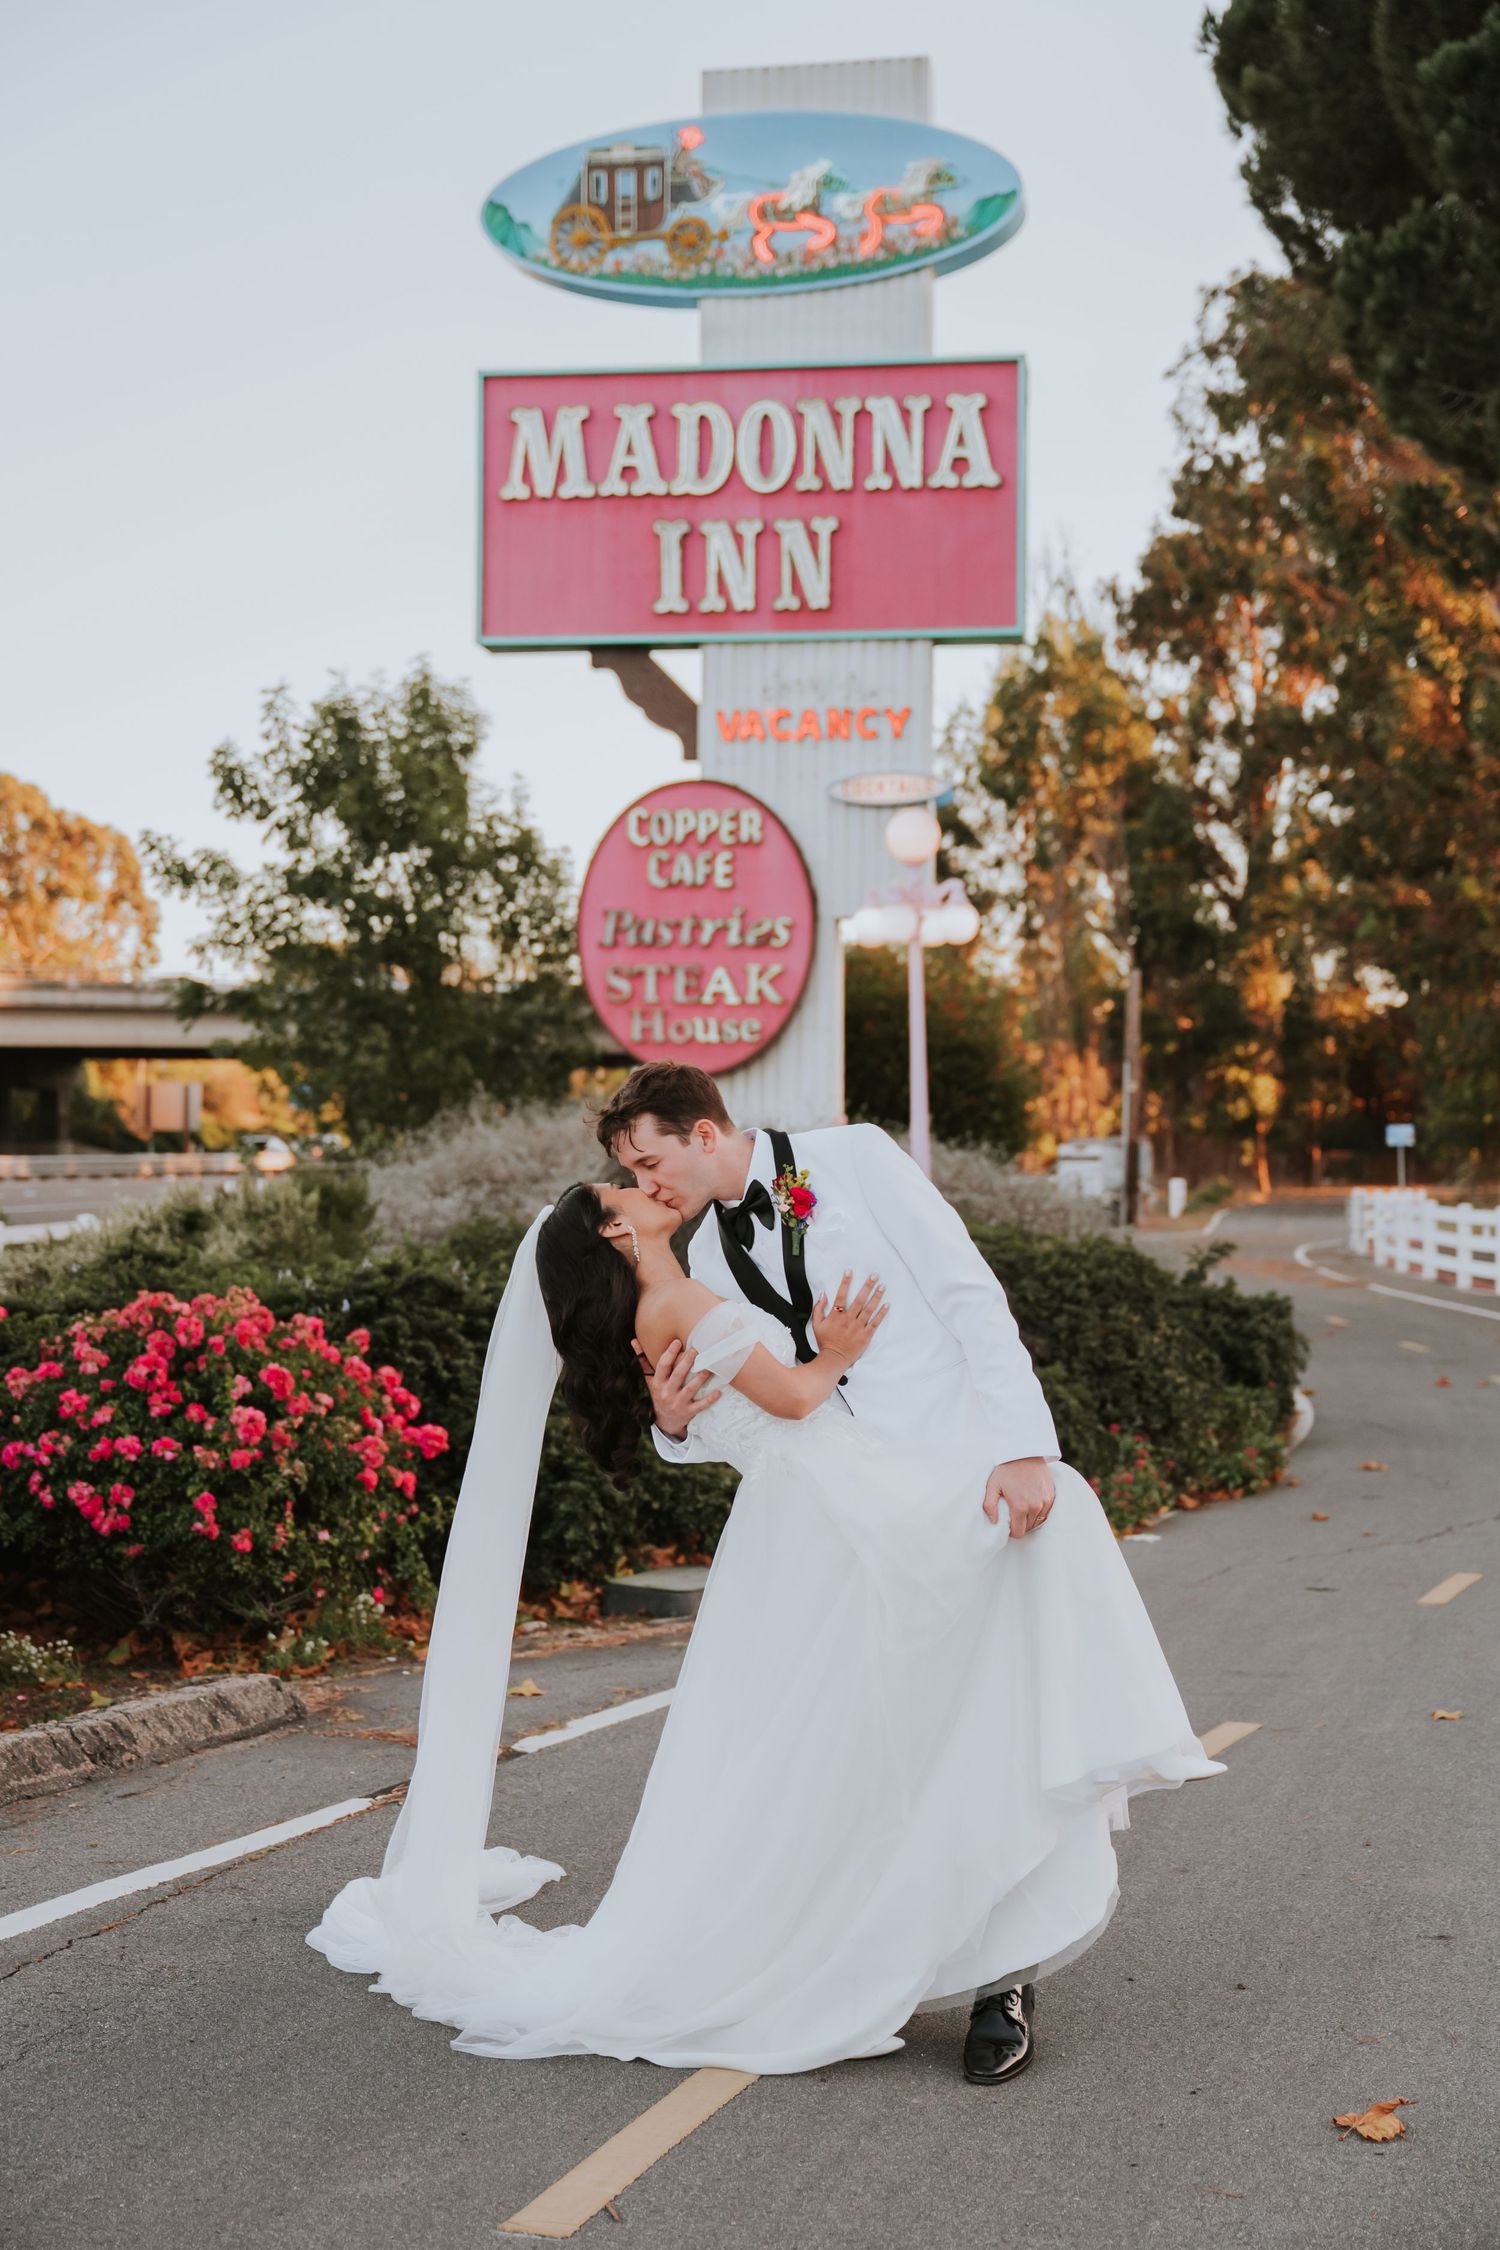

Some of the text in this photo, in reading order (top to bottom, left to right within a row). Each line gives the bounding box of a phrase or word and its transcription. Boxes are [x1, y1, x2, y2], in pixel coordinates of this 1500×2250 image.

[500, 393, 1002, 500] MADONNA
[652, 516, 839, 614] INN
[716, 706, 912, 743] VACANCY
[627, 806, 763, 847] COPPER
[647, 851, 735, 888] CAFE
[600, 905, 794, 947] Pastries
[606, 962, 785, 1005] STEAK
[630, 1008, 763, 1044] House
